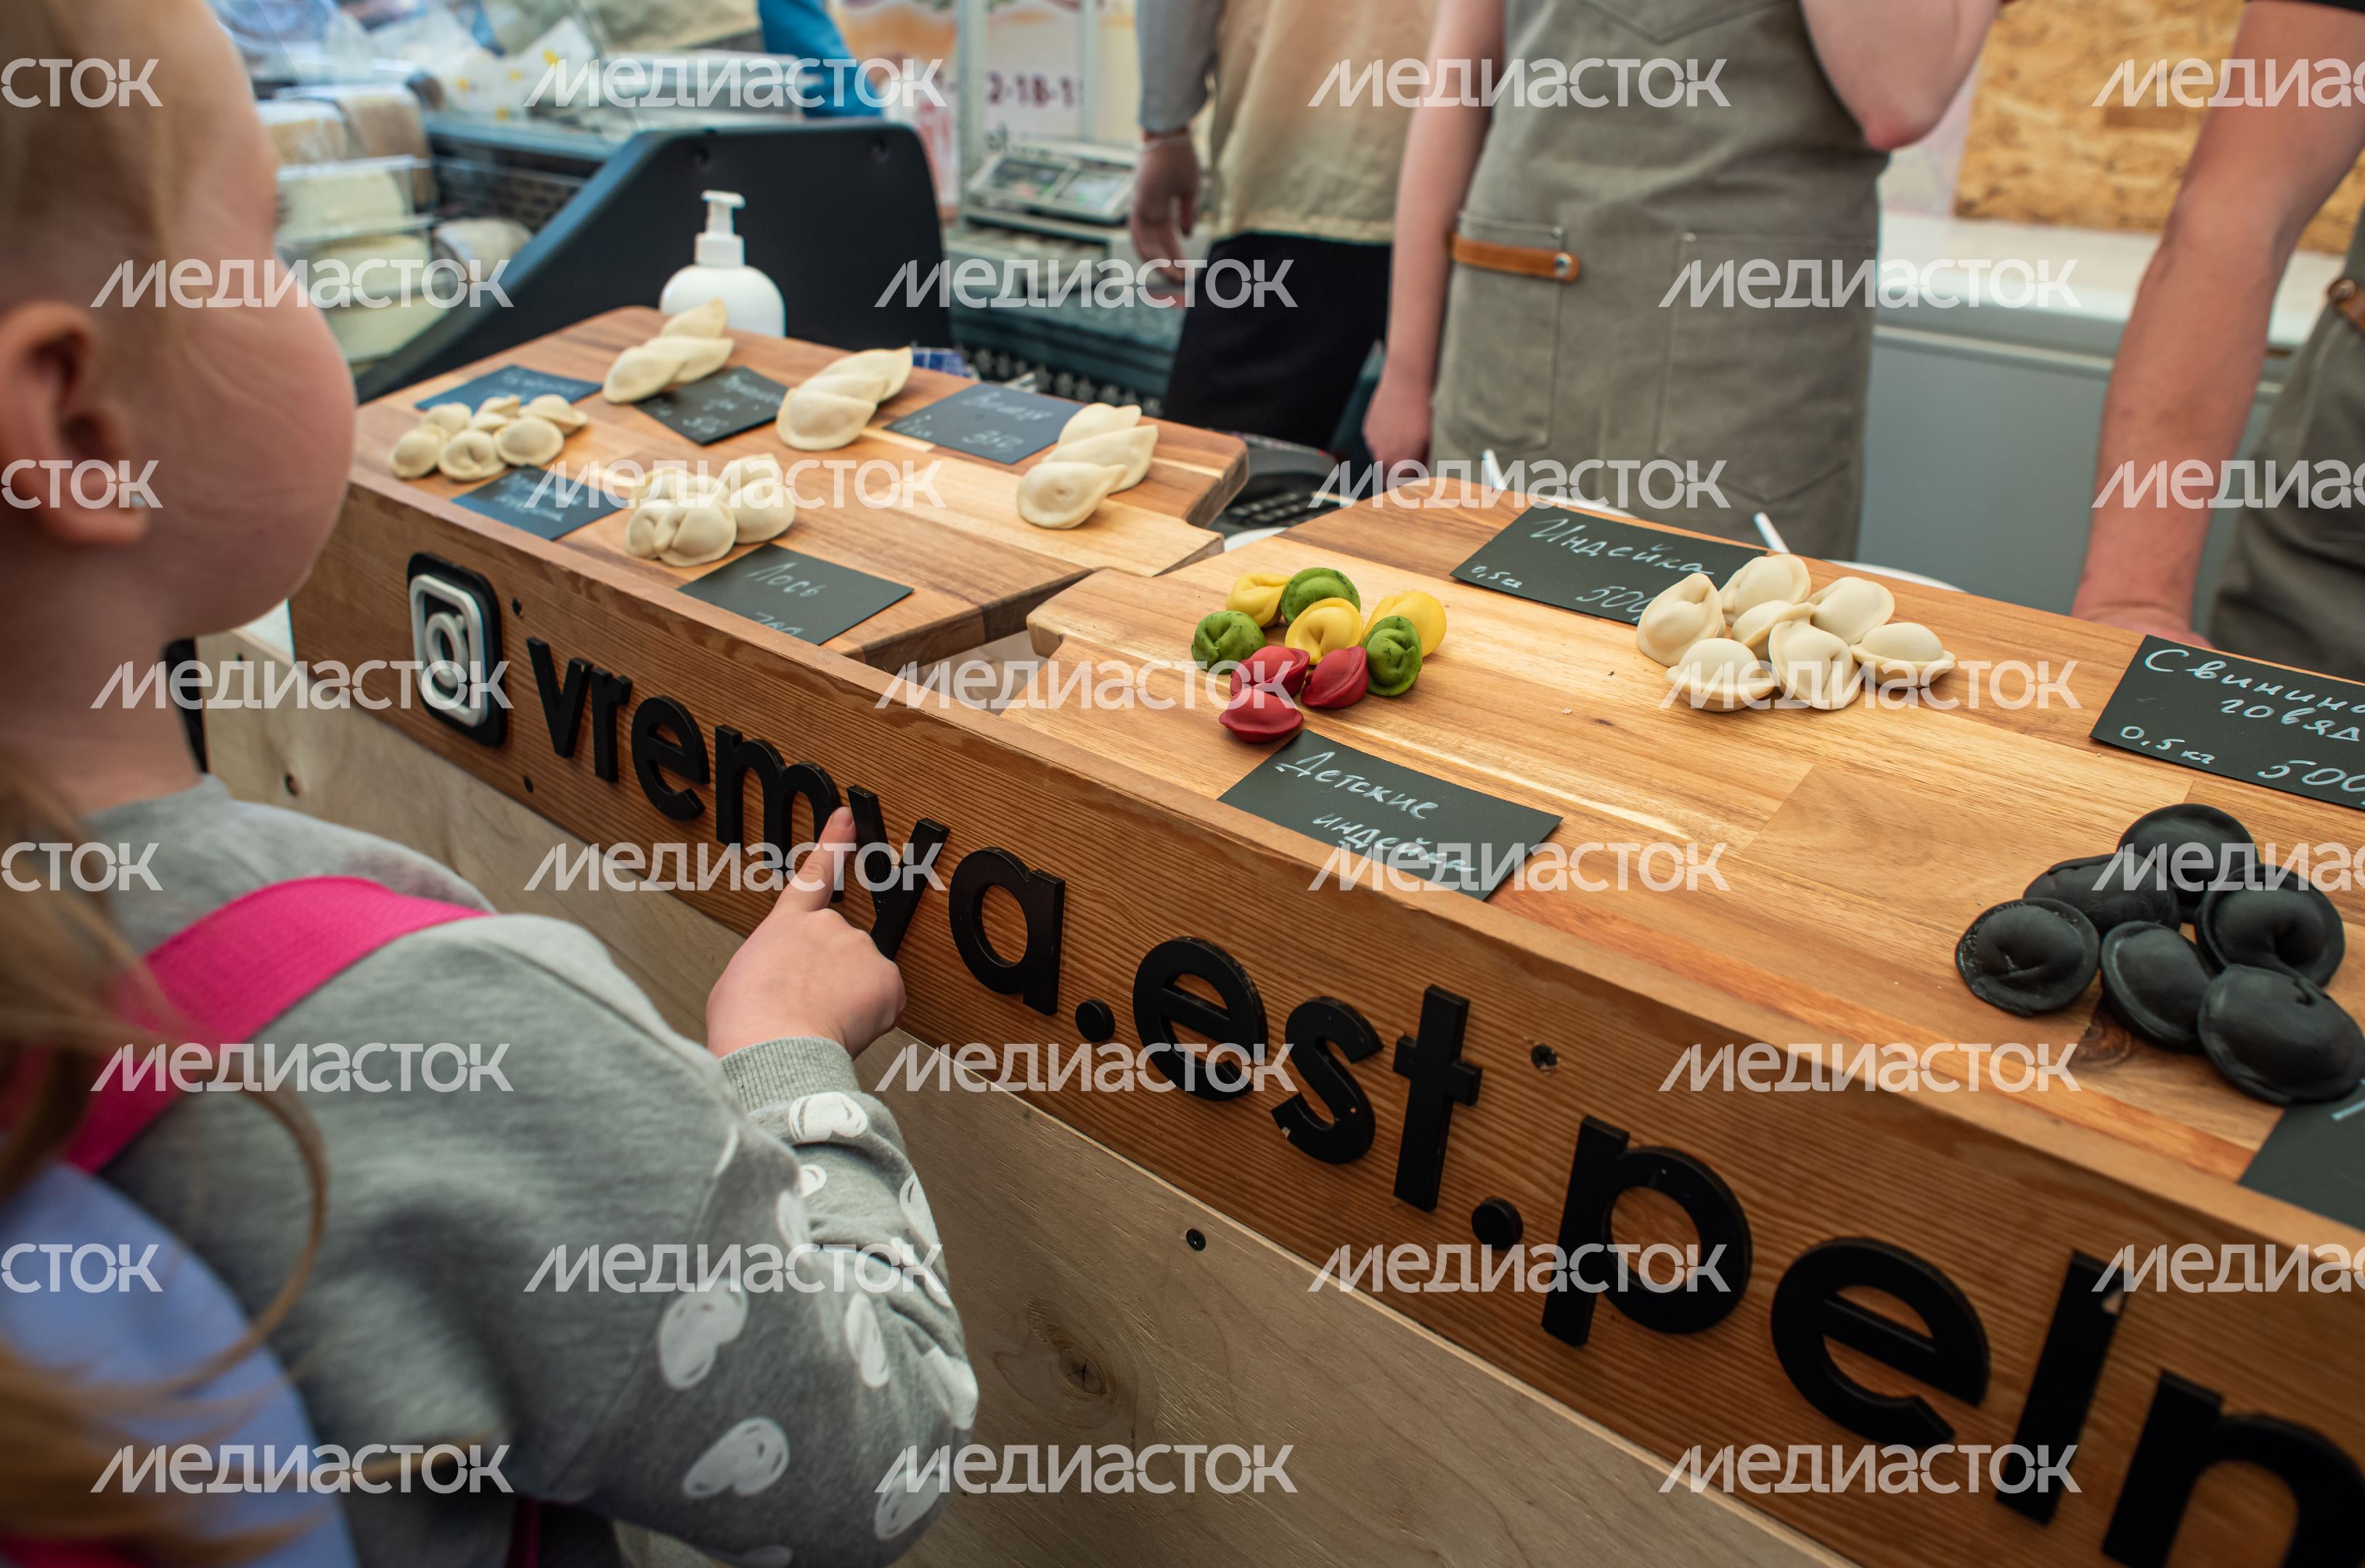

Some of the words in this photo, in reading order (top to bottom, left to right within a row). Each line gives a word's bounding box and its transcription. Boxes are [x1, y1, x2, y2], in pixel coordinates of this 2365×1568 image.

[1533, 518, 1714, 575] Индейка
[746, 562, 826, 597] Лось
[1275, 751, 1439, 820] Детские
